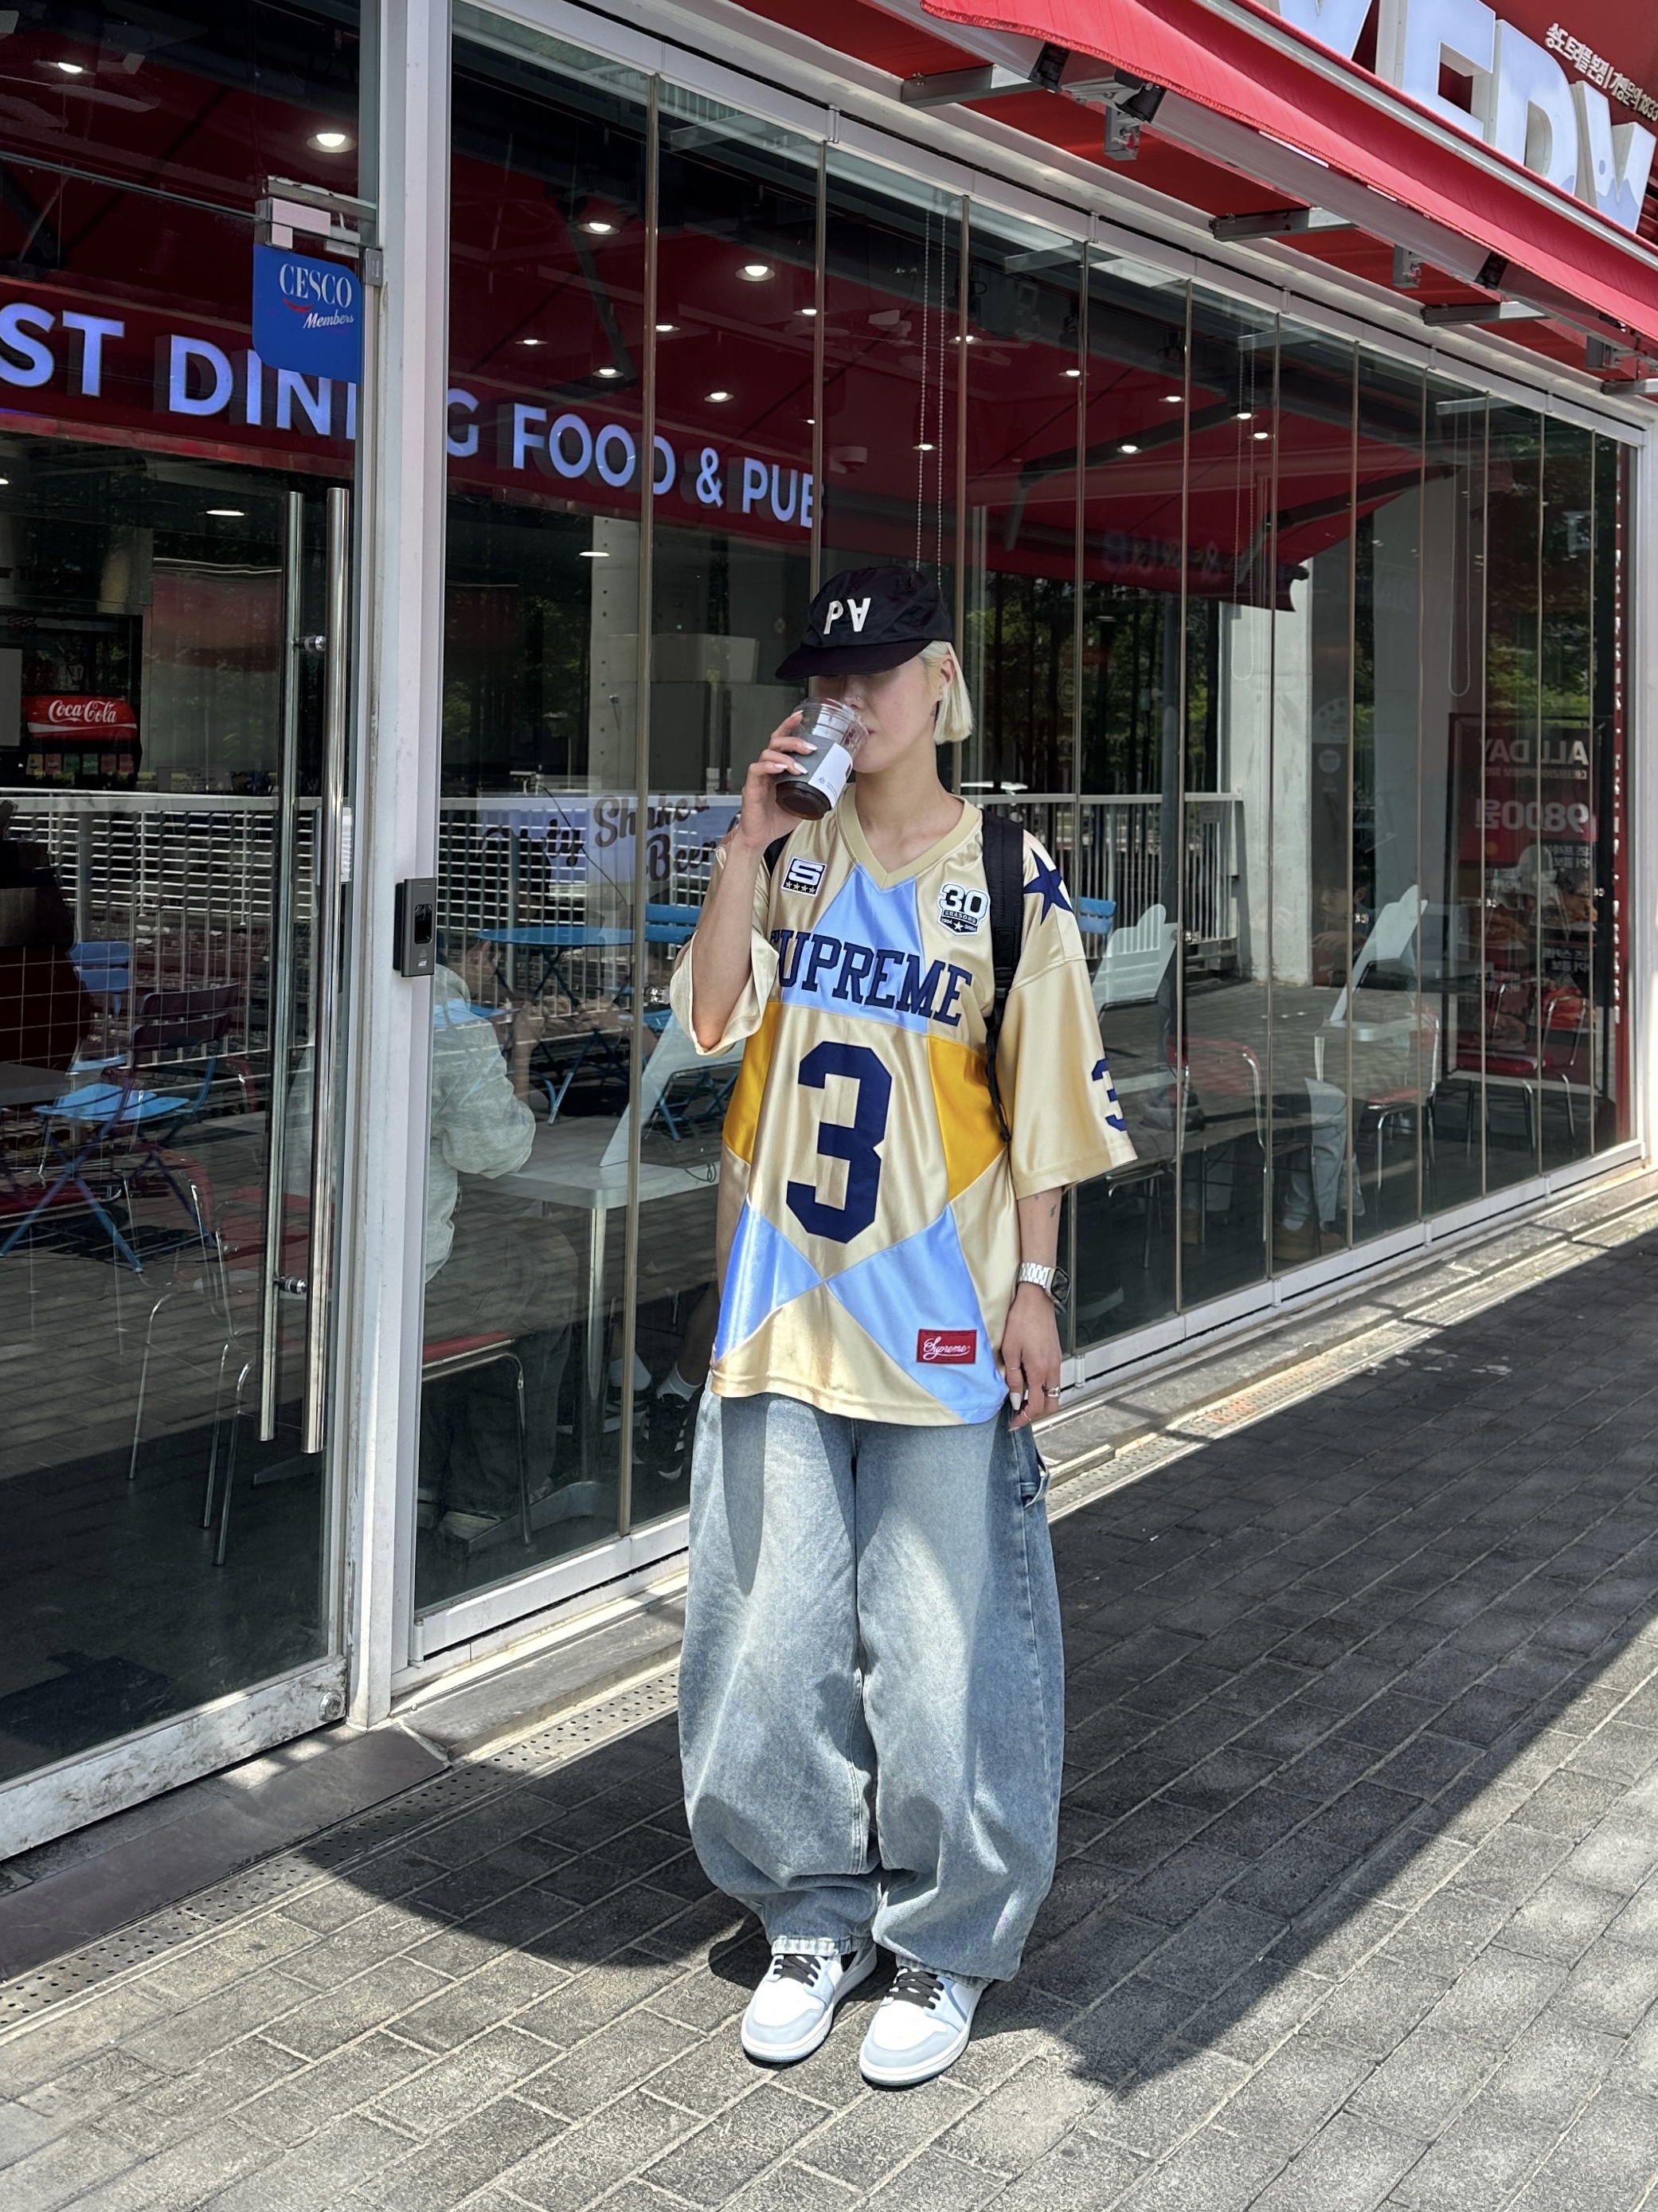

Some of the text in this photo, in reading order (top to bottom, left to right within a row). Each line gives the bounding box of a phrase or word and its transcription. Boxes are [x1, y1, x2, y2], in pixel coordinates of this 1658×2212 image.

[280, 264, 352, 308] CESCO
[303, 309, 354, 329] Members
[0, 302, 125, 398] ST
[696, 447, 723, 507] &
[49, 699, 117, 723] Coca-Cola
[939, 884, 989, 920] 30
[770, 929, 973, 1027] UPREME
[786, 1040, 892, 1244] 3
[922, 1336, 971, 1361] Supreme
